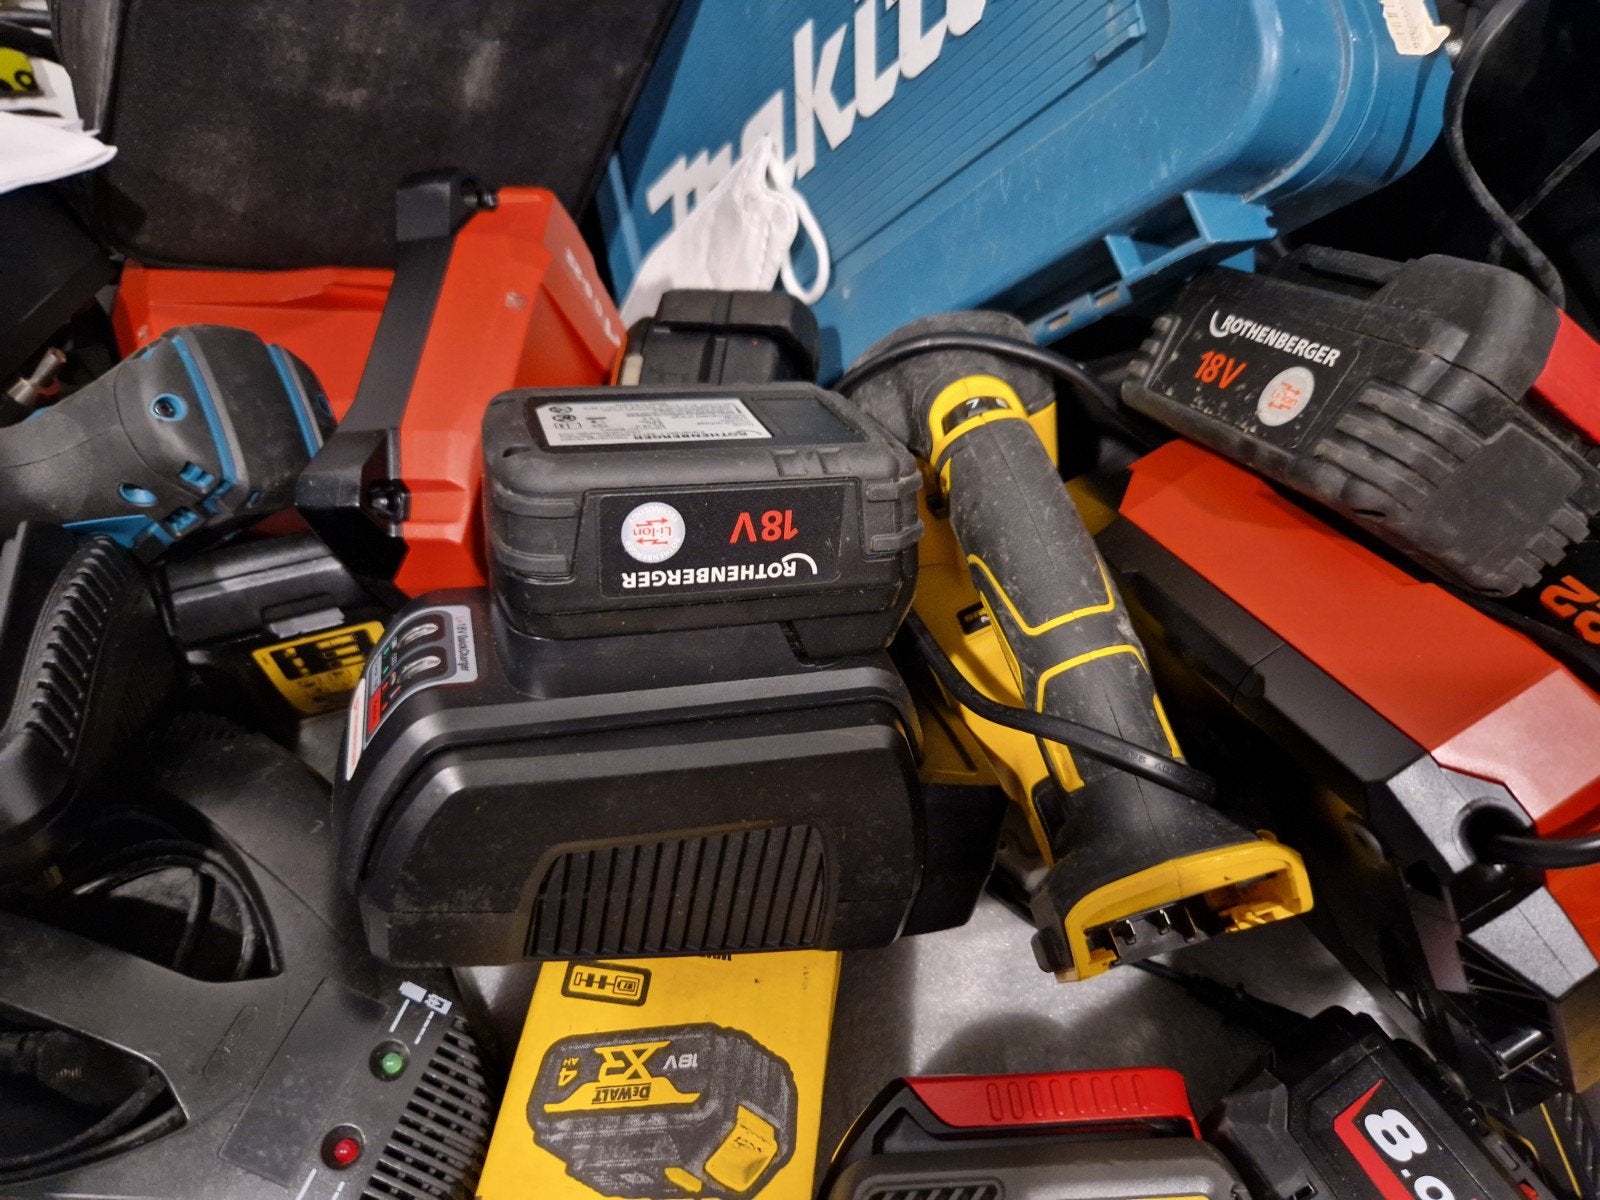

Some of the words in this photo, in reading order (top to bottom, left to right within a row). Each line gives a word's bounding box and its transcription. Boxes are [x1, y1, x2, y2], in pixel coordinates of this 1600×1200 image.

[1209, 310, 1341, 367] ROTHENBERGER
[1194, 350, 1248, 390] 18V
[632, 526, 672, 538] Li-Ion
[729, 510, 799, 544] 18V
[621, 553, 818, 589] ROTHENBERGER
[558, 1068, 578, 1086] 4
[662, 1053, 698, 1070] 18V
